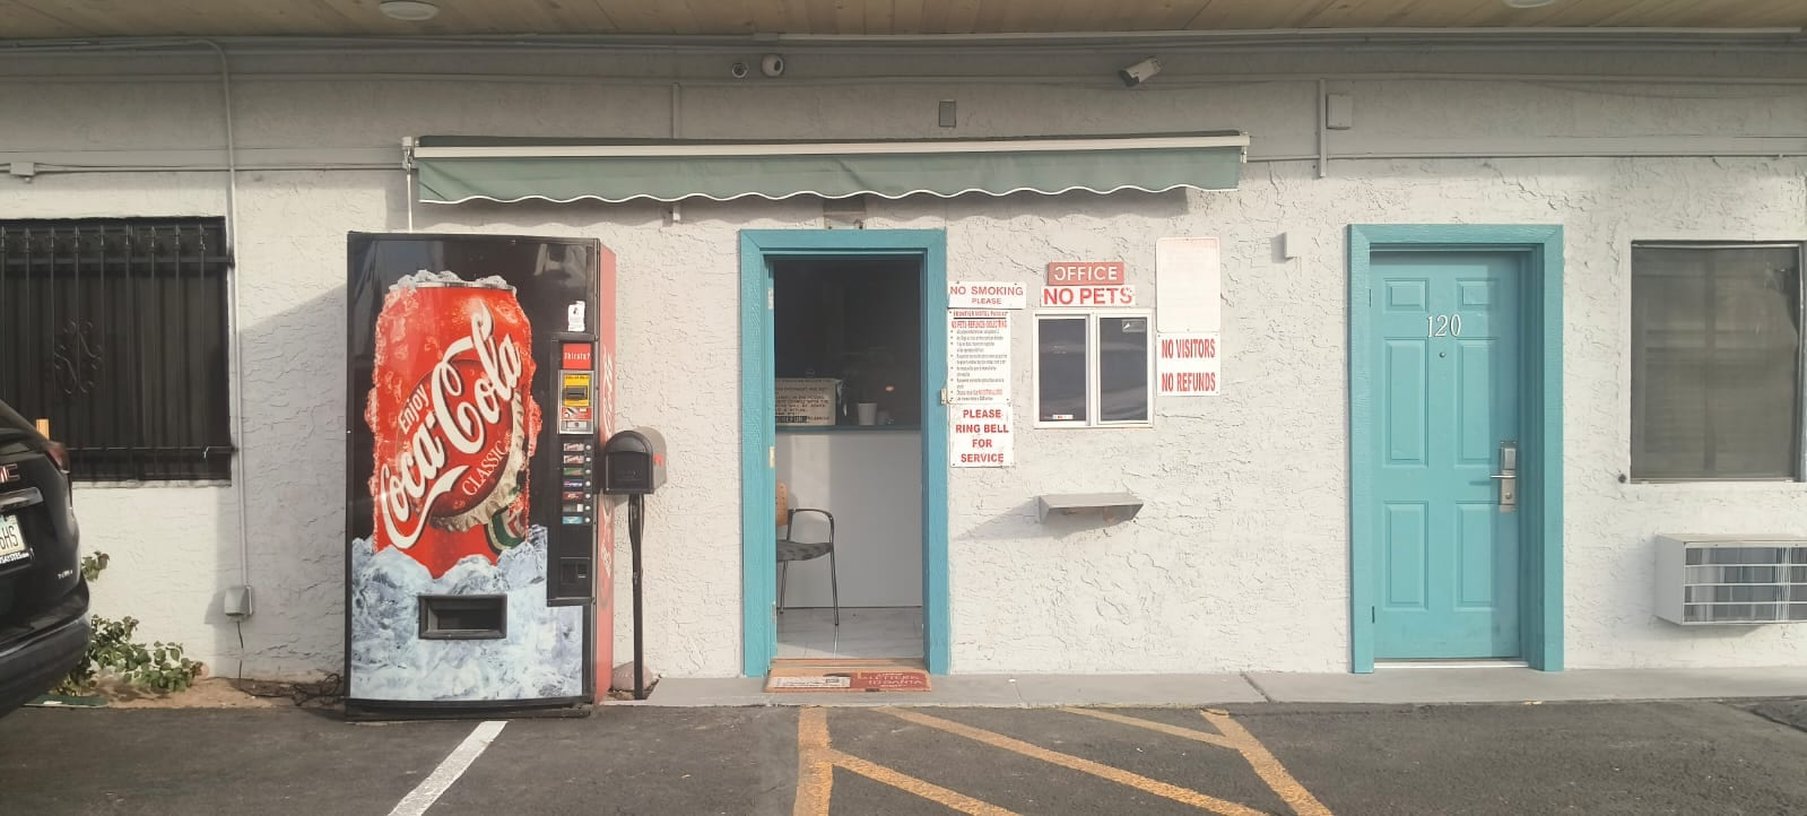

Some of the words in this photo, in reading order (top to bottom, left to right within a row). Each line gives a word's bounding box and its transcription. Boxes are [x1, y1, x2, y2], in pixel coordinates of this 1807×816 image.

[1054, 266, 1118, 281] OFFICE
[950, 286, 966, 295] NO
[971, 286, 1023, 296] SMOKING
[1043, 287, 1074, 305] NO
[1079, 287, 1133, 304] PETS
[971, 297, 1003, 305] PLEASE
[1427, 314, 1462, 338] 120
[1161, 338, 1174, 359] NO
[1175, 338, 1216, 359] VISITORS
[1161, 372, 1174, 392] NO
[1176, 372, 1216, 392] REFUNDS
[398, 385, 430, 435] Enjoy
[963, 409, 1002, 418] PLEASE
[955, 424, 981, 433] RING
[983, 424, 1009, 433] BELL
[972, 439, 993, 448] FOR
[960, 453, 1004, 463] SERVICE
[461, 443, 509, 497] CLASSIC
